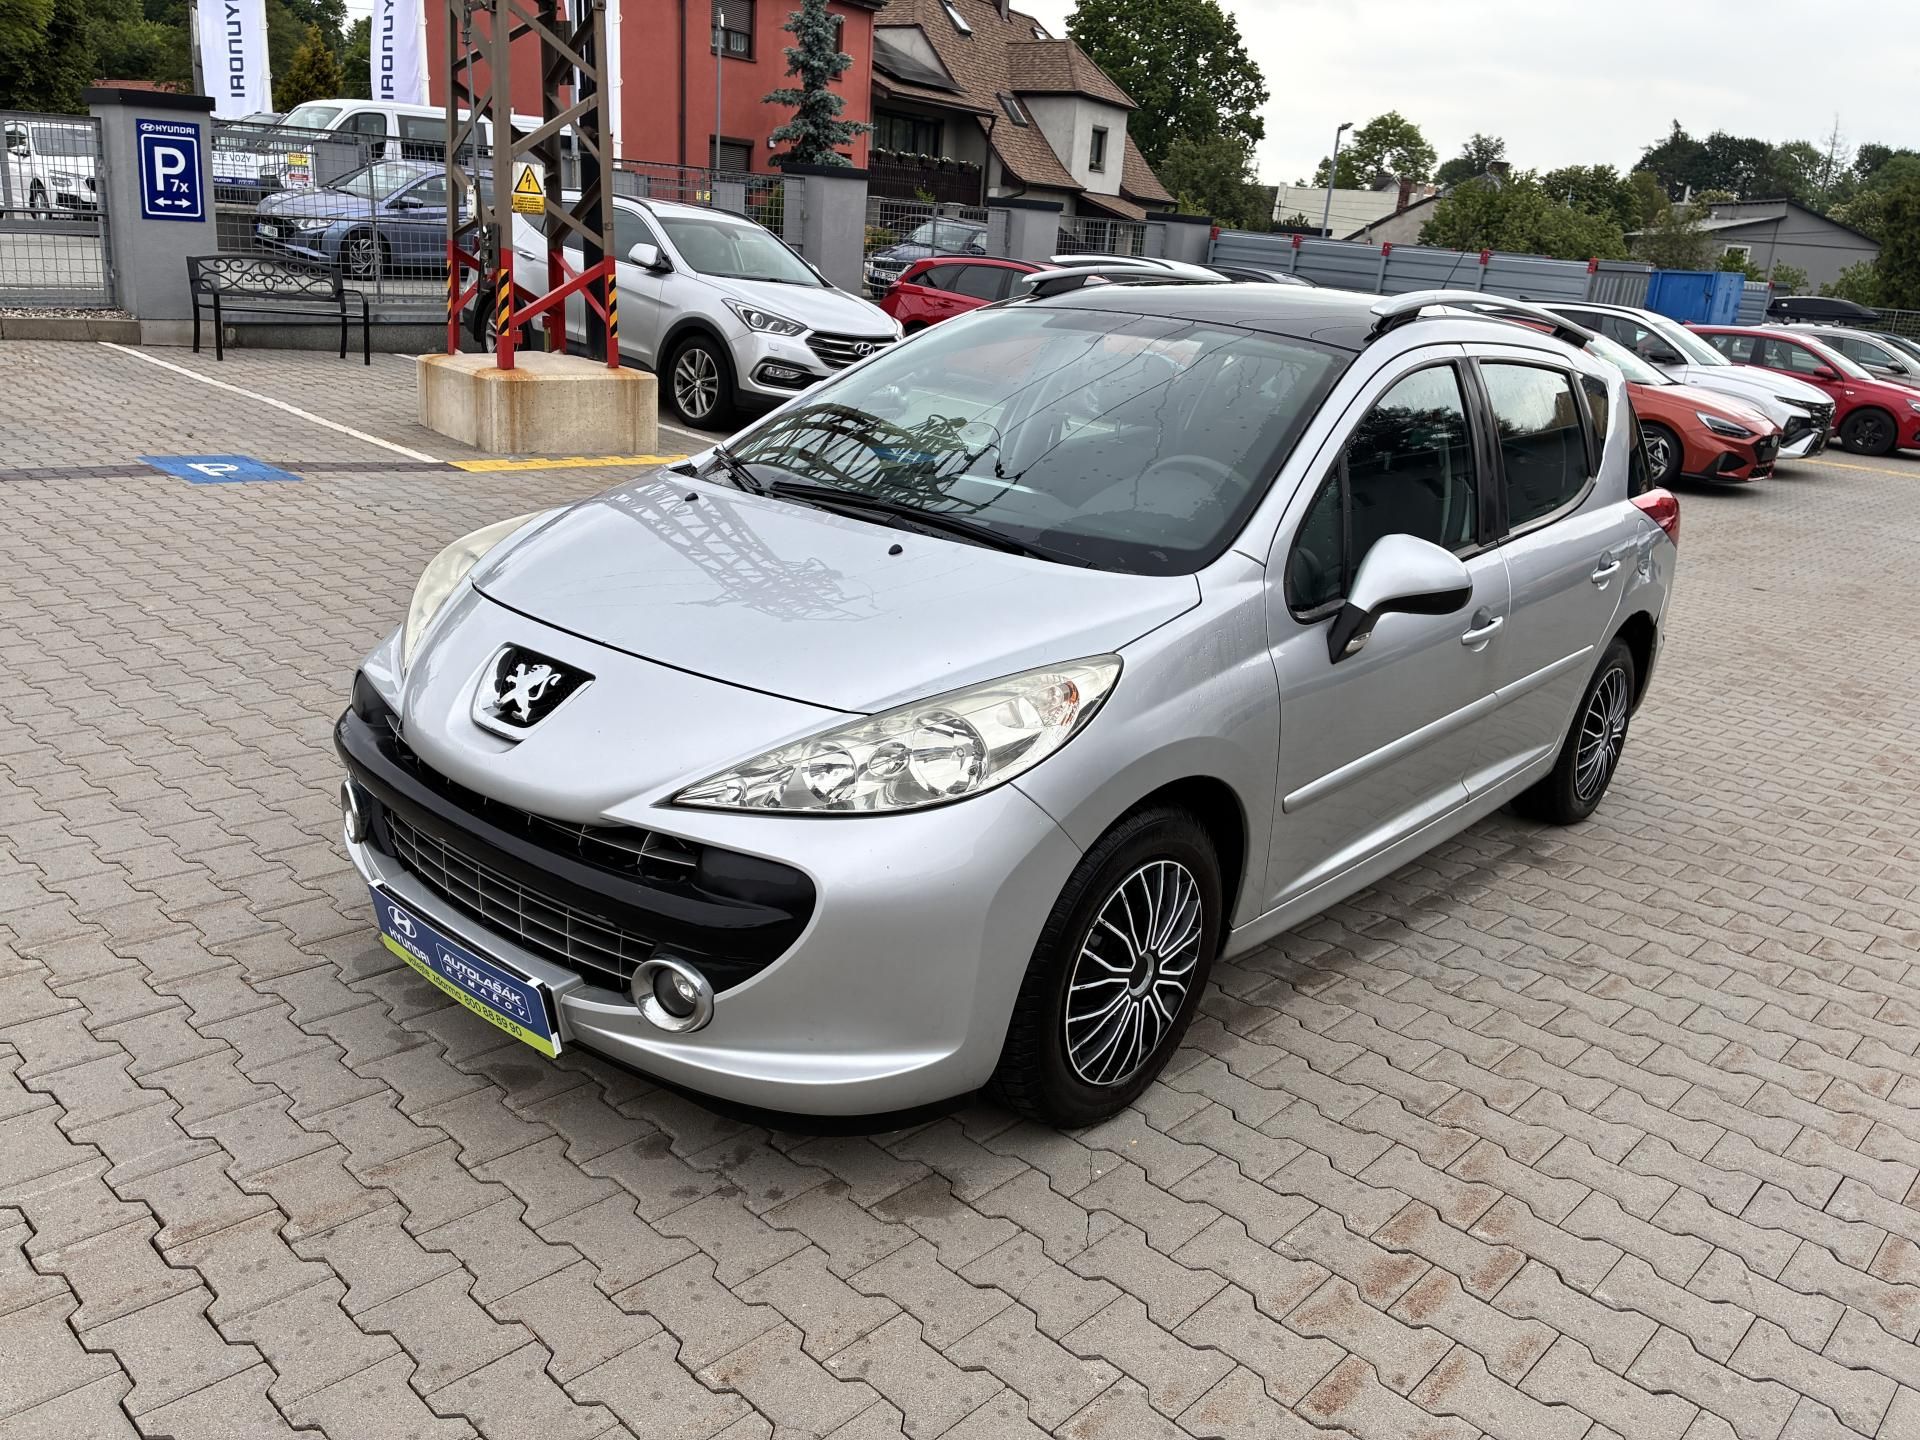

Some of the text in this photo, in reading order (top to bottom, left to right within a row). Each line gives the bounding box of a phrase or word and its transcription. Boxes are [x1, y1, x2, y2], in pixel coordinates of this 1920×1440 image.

[155, 124, 195, 135] HYUNDAI
[154, 146, 186, 191] P
[230, 153, 252, 163] VOZY
[170, 179, 189, 193] 7x
[388, 926, 431, 966] HYUNDAI
[443, 953, 522, 1006] AUTOLAŠÁK
[446, 965, 525, 1016] RÝMAŘOV
[431, 973, 462, 1000] zdarma
[464, 994, 481, 1012] 800
[482, 1006, 495, 1021] 88
[495, 1013, 508, 1028] 89
[508, 1022, 522, 1037] 90
